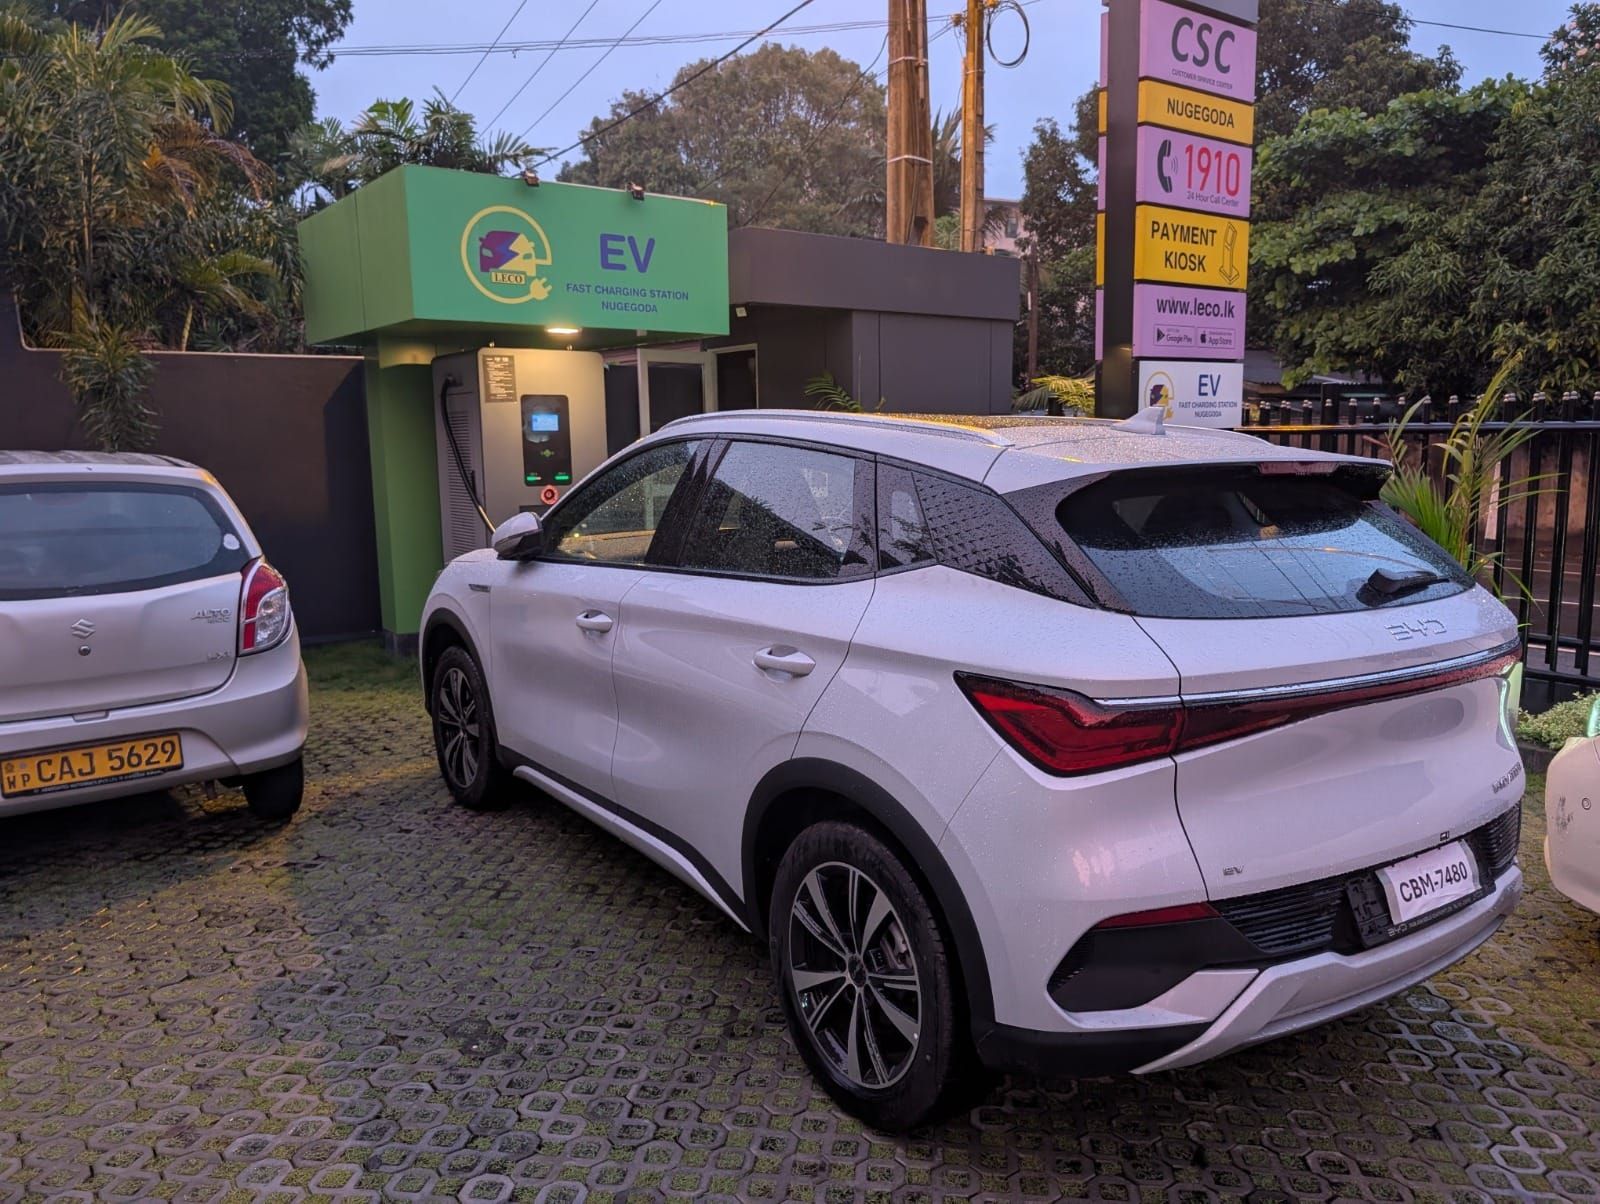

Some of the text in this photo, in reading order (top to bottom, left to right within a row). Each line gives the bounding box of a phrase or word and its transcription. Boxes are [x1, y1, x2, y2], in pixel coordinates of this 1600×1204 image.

[1171, 17, 1235, 74] CSC
[1171, 69, 1196, 81] CUSTOMER
[1167, 97, 1235, 128] NUGEGODA
[1185, 143, 1241, 197] 1910
[1195, 191, 1209, 203] Hour
[1210, 194, 1221, 205] Call
[1151, 220, 1217, 247] PAYMENT
[600, 233, 656, 273] EV
[1164, 251, 1206, 273] KIOSK
[494, 273, 524, 284] LECO
[566, 283, 689, 301] FAST CHARGING STATION
[601, 301, 658, 313] NUGEGODA
[1156, 297, 1235, 319] www.leco.lk
[1166, 333, 1183, 344] Google
[1208, 336, 1233, 346] App Store
[1198, 374, 1221, 397] EV
[1178, 401, 1238, 409] FAST CHARGING STATION
[36, 751, 96, 783] CAJ
[107, 738, 177, 772] 5629
[1398, 860, 1469, 904] CBM-7480
